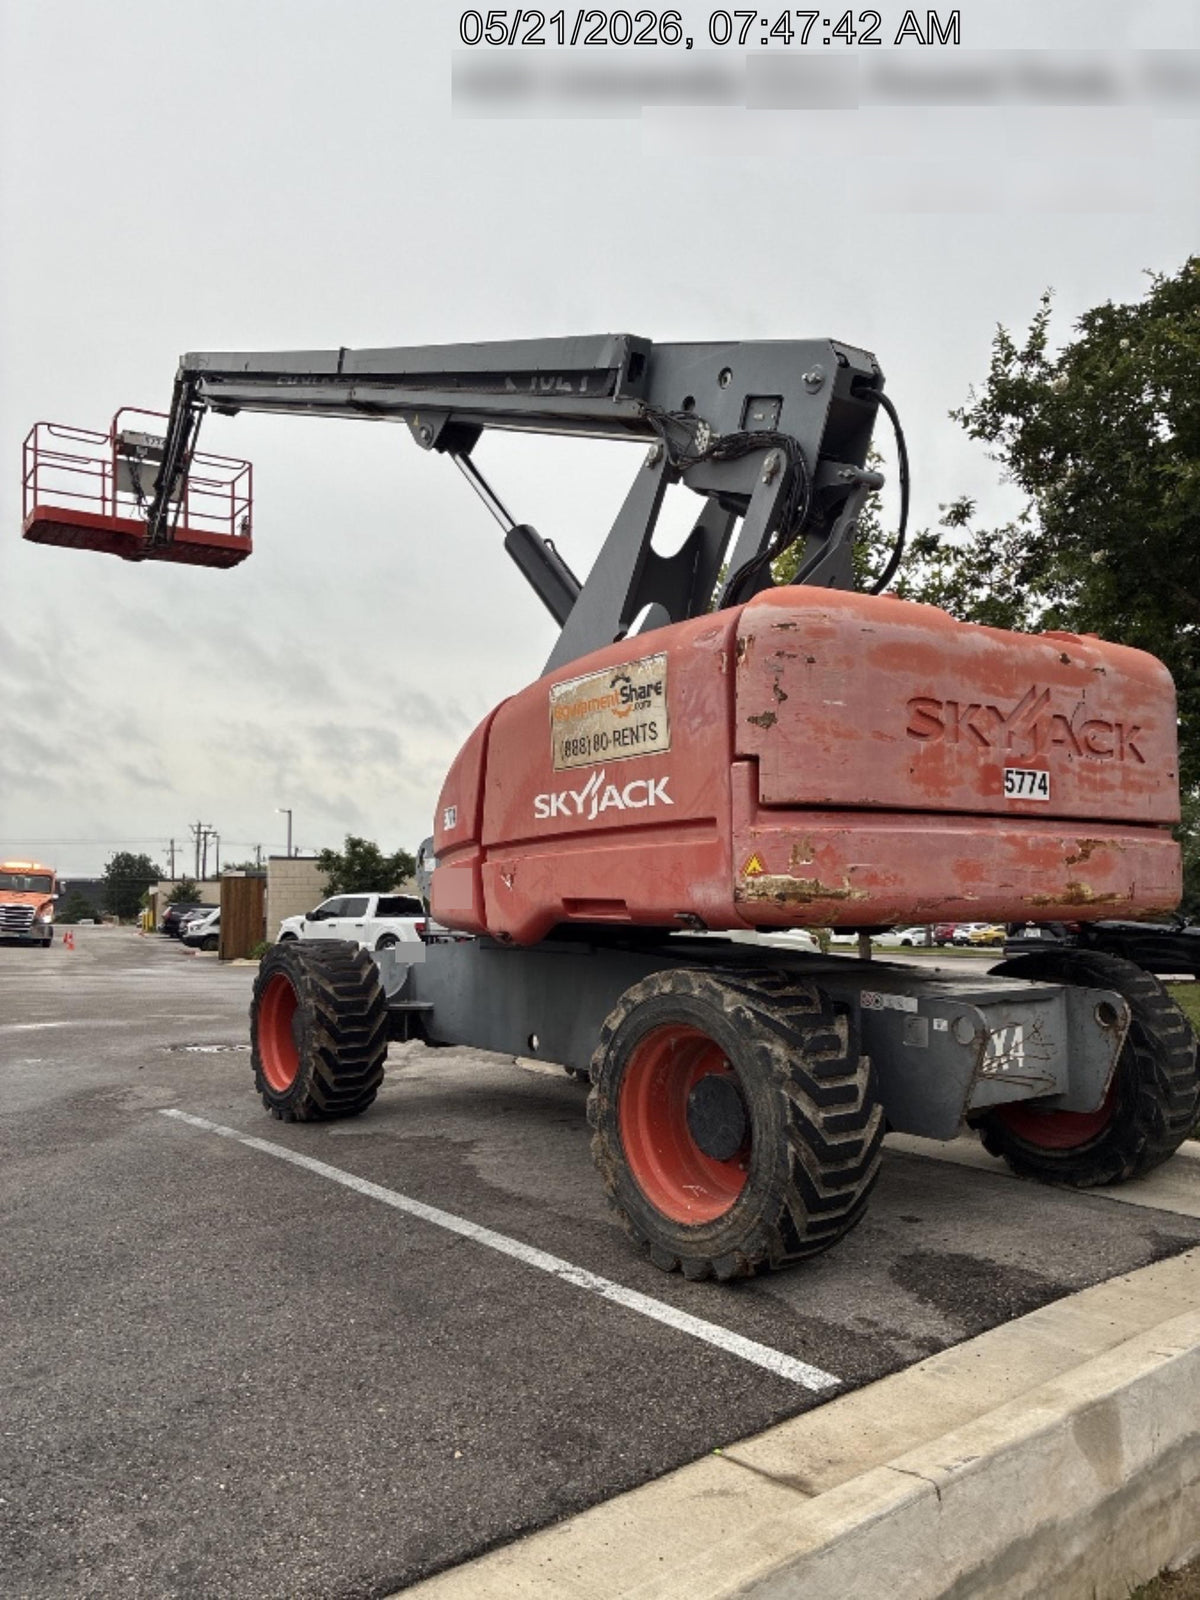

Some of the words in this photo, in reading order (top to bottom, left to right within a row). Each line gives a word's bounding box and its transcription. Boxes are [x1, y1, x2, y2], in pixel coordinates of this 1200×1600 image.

[906, 685, 1146, 764] SKYJACK
[534, 769, 675, 820] SKYJACK
[1004, 769, 1048, 795] 5774
